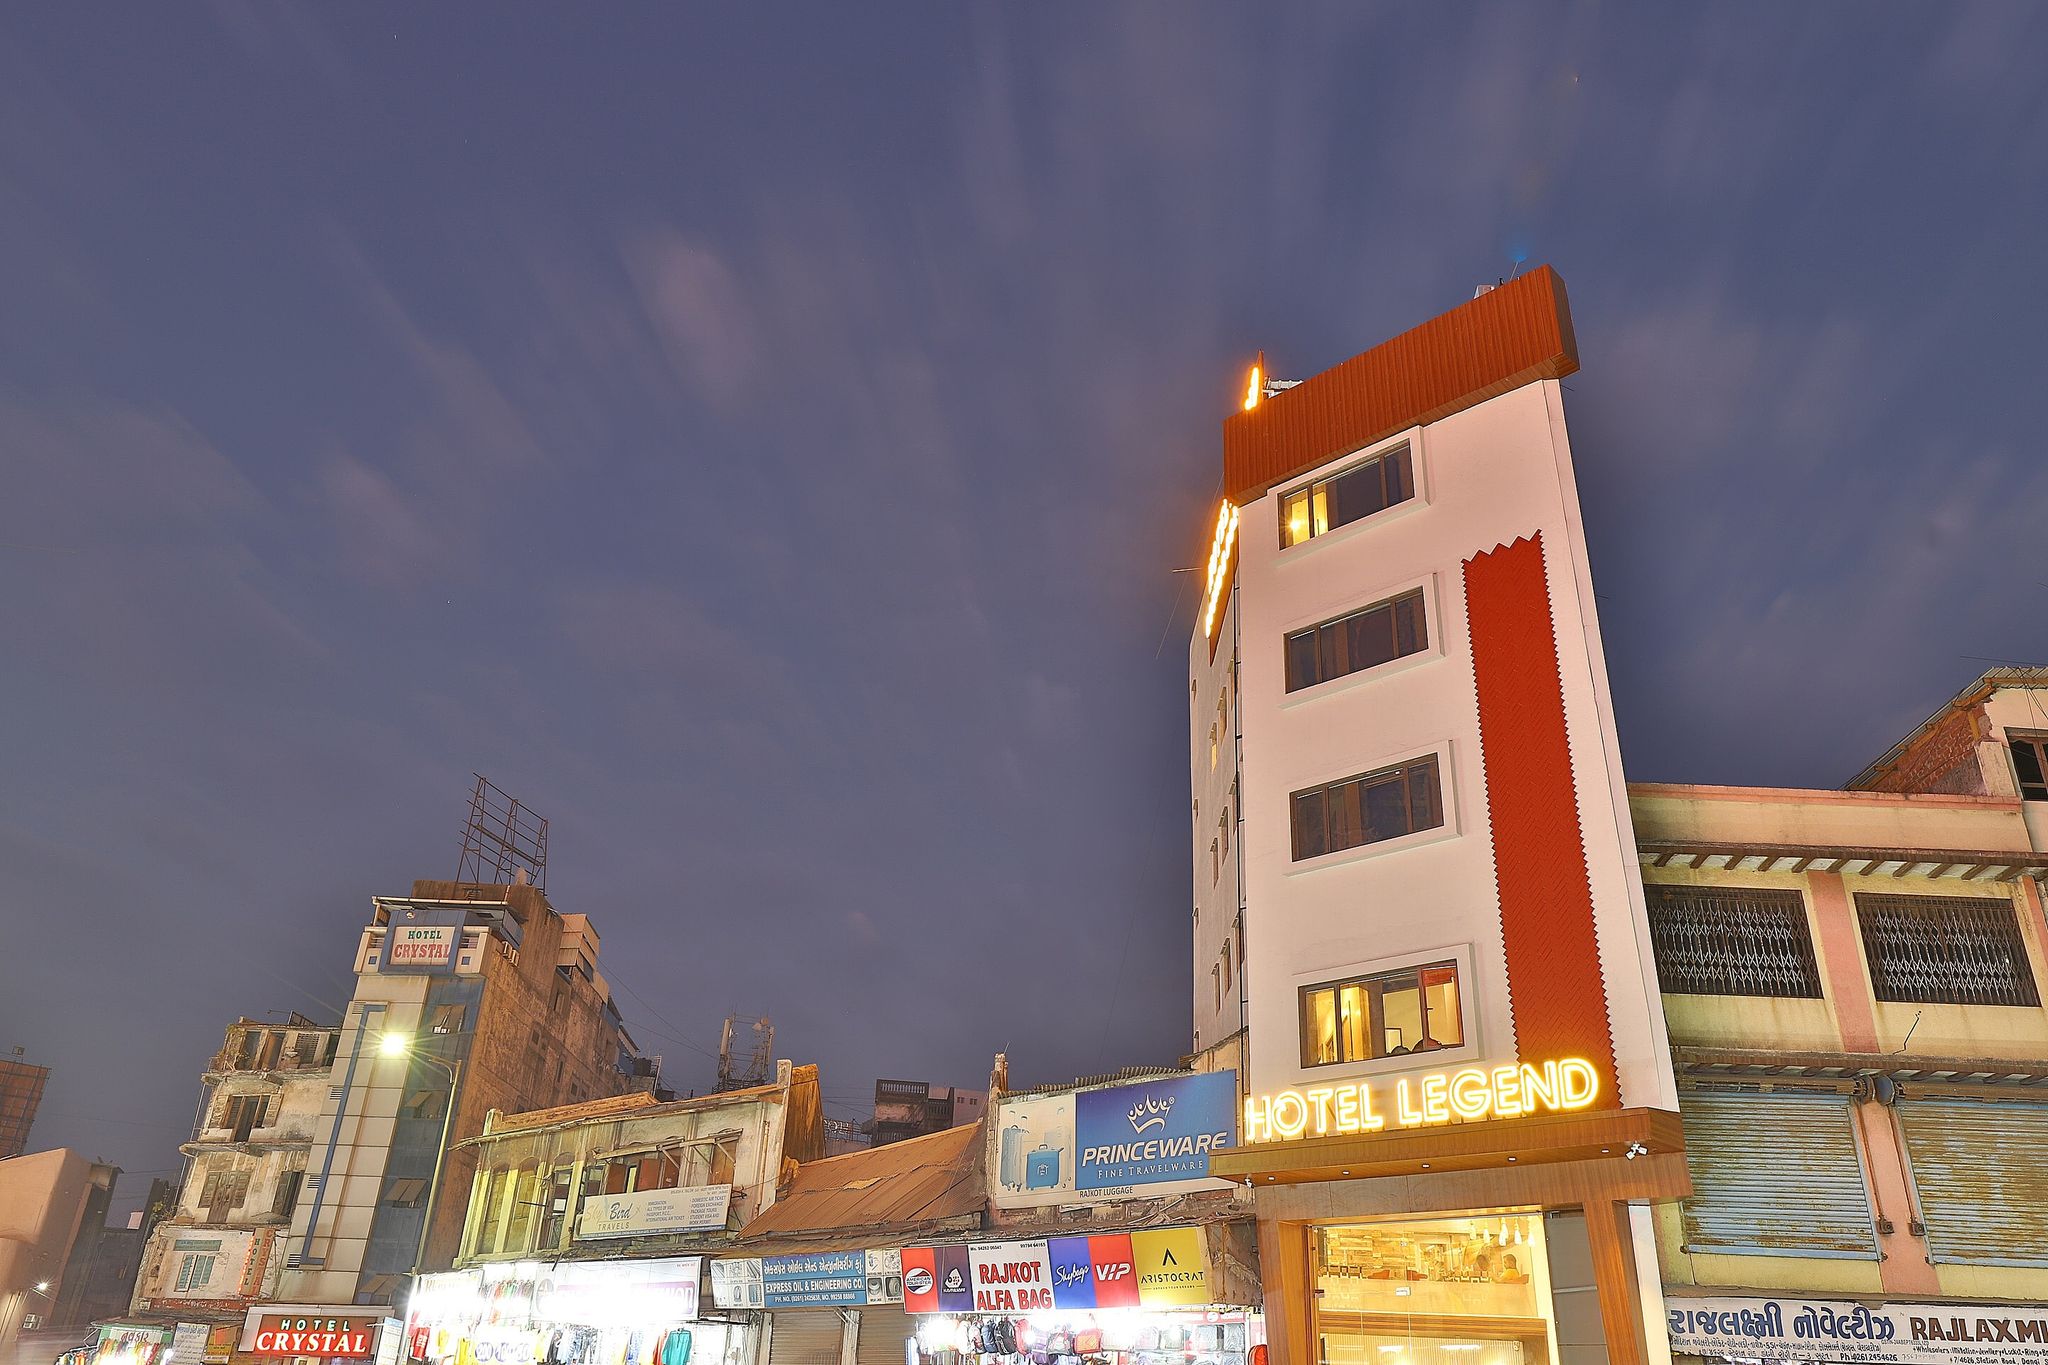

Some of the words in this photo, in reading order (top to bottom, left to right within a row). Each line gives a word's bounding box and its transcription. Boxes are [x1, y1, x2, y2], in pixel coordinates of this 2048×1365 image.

[408, 930, 442, 939] HOTEL
[394, 943, 450, 958] CRYSTAL
[1245, 1082, 1383, 1142] HOTEL
[1397, 1057, 1600, 1127] LEGEND
[1081, 1131, 1228, 1167] PRINCEWARE
[1098, 1168, 1124, 1179] FINE
[1079, 1187, 1102, 1198] RAJKOT
[1103, 1185, 1134, 1197] LUGGAGE
[598, 1221, 630, 1231] TRAVELS
[978, 1261, 1042, 1284] RAJKOT
[1054, 1263, 1090, 1288] Skybags
[1095, 1262, 1131, 1281] VIP
[1140, 1271, 1204, 1284] ARISTOCRAT
[765, 1282, 792, 1293] EXPRESS
[793, 1281, 804, 1292] OIL
[804, 1280, 809, 1291] &
[810, 1279, 852, 1291] ENGINEERING
[852, 1278, 864, 1289] CO.
[977, 1289, 1016, 1311] ALFA
[1017, 1287, 1053, 1310] BAG
[280, 1319, 350, 1332] HOTEL
[1668, 1301, 1785, 1341] રાજલક્ષ્મી
[256, 1331, 367, 1353] CRYSTAL
